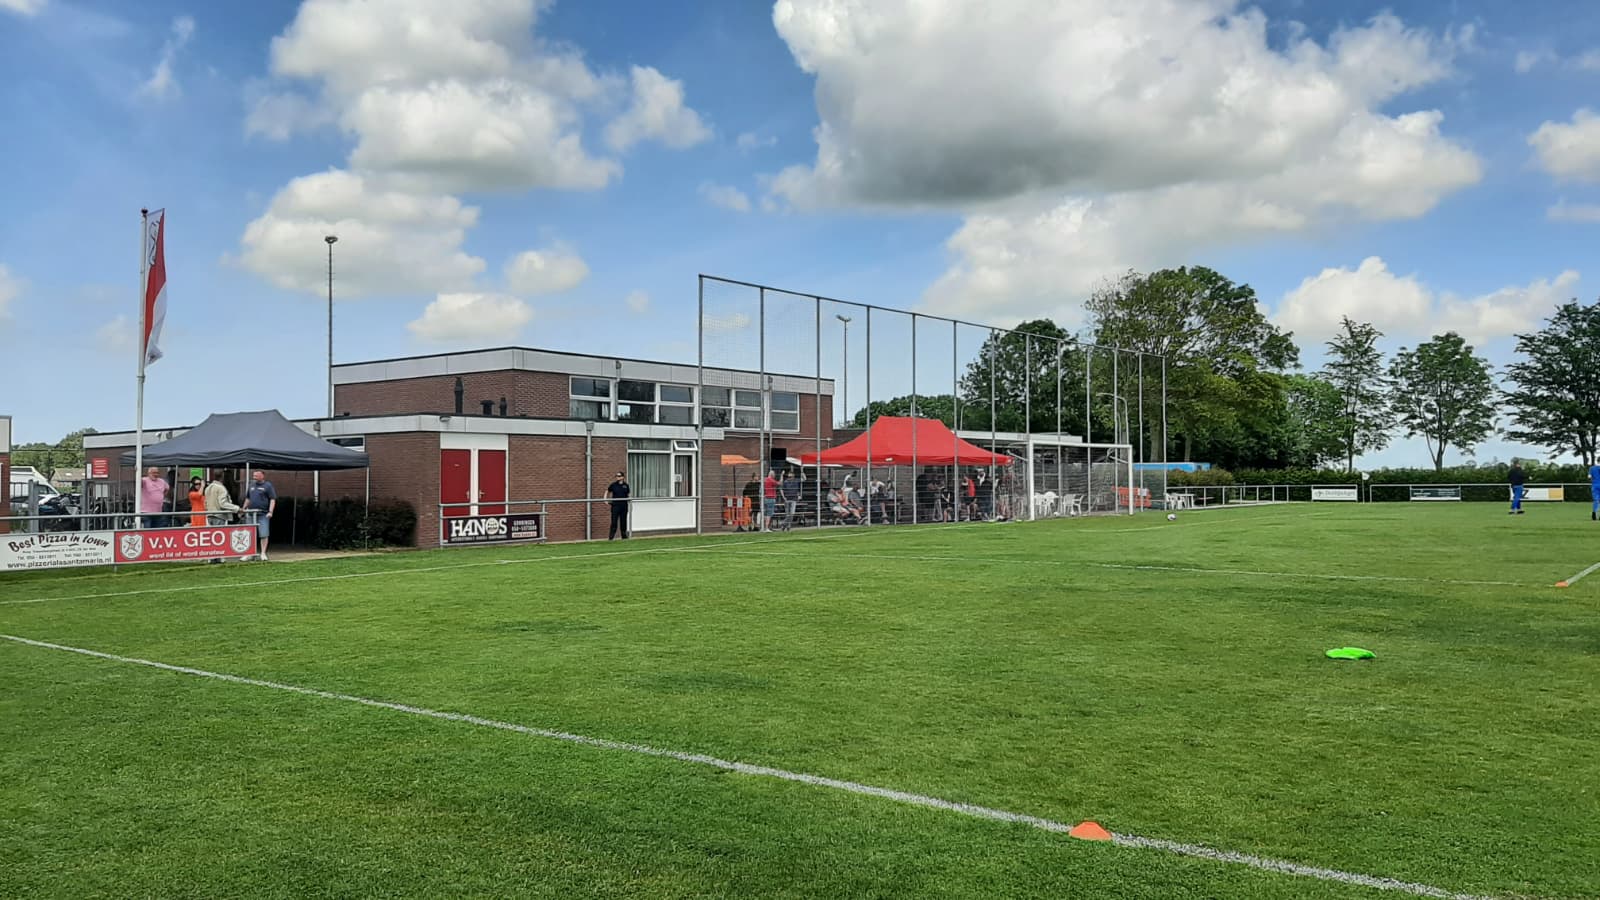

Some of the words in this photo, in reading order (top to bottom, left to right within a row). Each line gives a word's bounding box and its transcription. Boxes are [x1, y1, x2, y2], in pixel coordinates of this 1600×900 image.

[450, 517, 507, 537] HANOS
[8, 537, 35, 552] Best
[38, 534, 67, 544] Pizza
[70, 533, 80, 542] in
[82, 534, 109, 547] town
[184, 530, 226, 547] GEO
